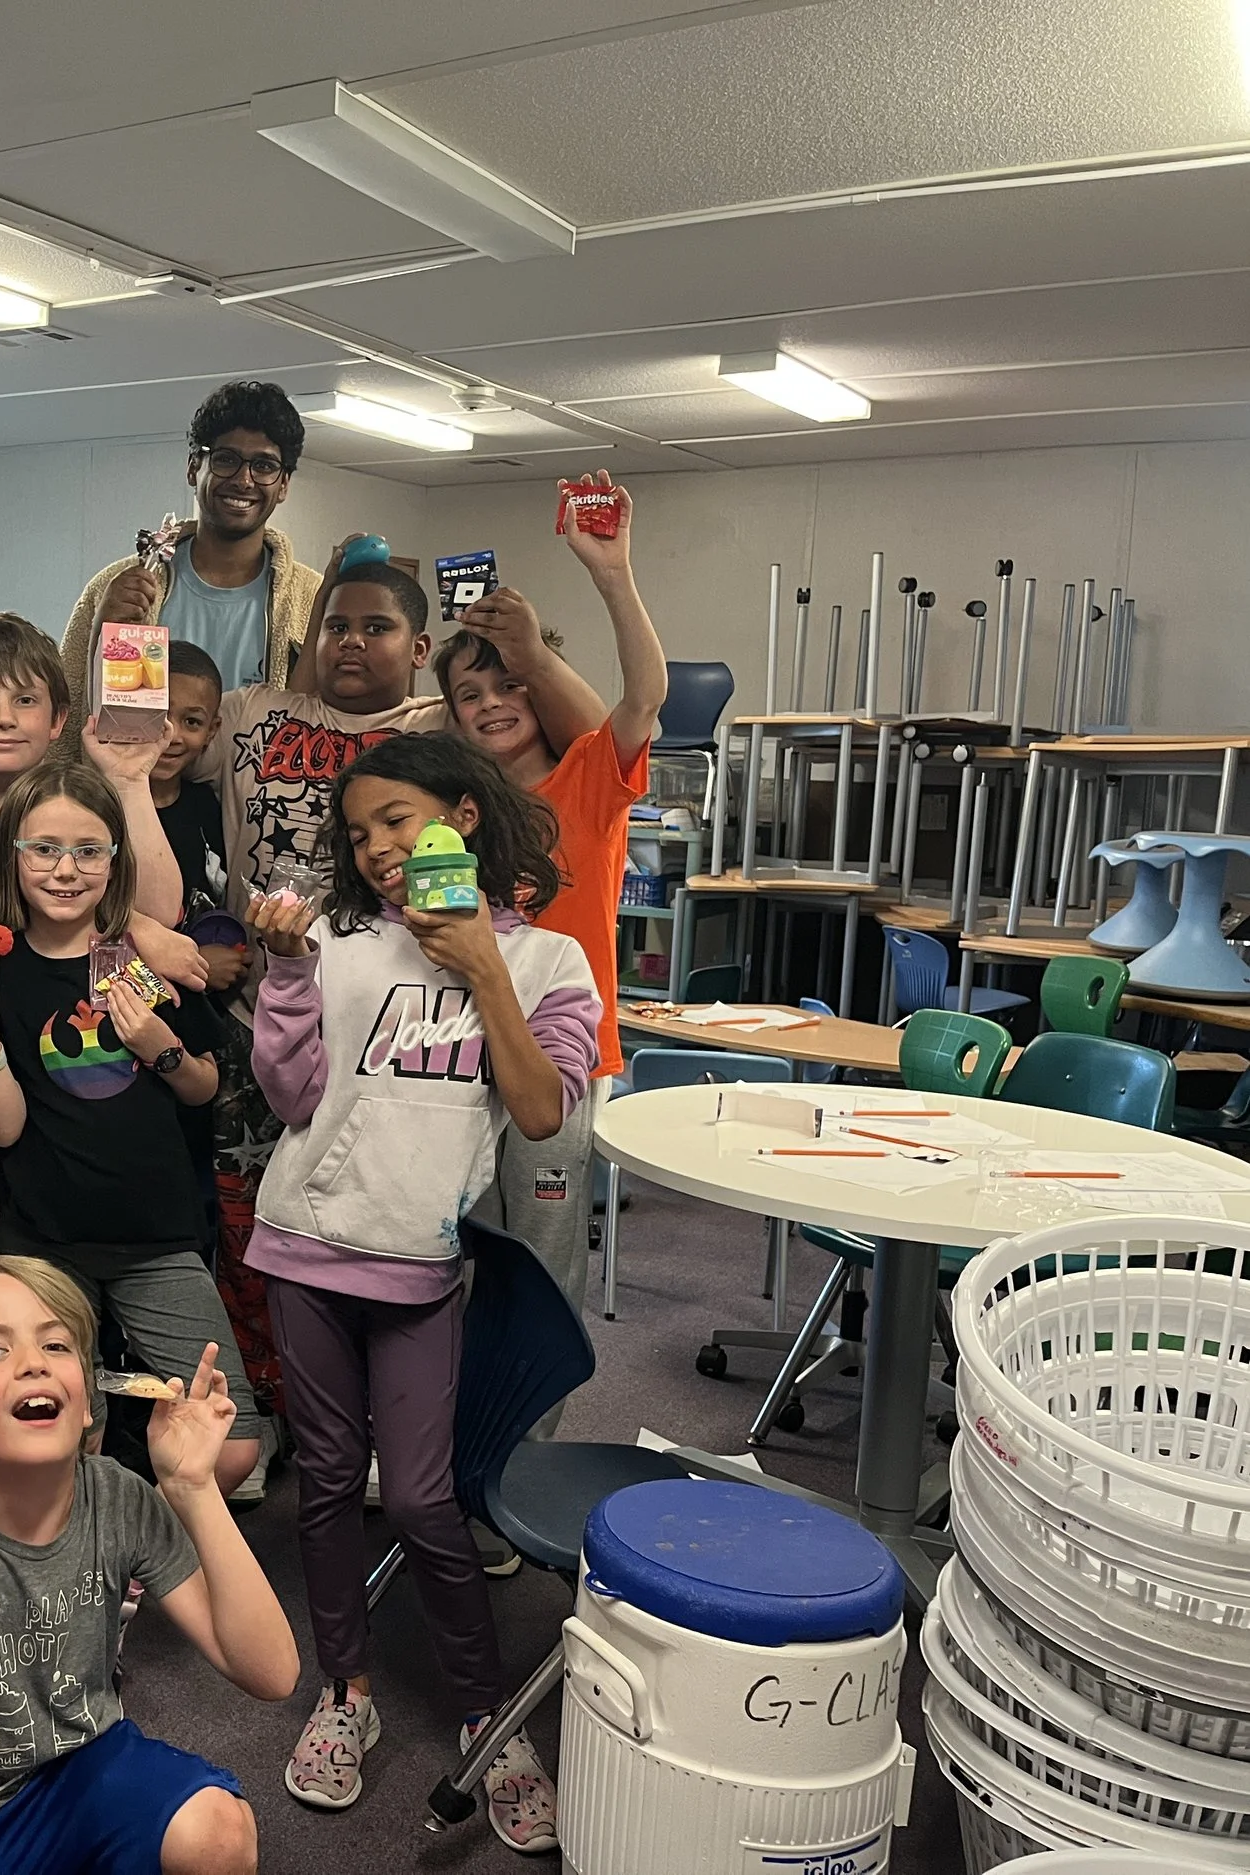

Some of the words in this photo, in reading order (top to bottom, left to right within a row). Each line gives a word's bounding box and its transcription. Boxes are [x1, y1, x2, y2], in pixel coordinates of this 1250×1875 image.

[568, 493, 615, 506] Skittles
[442, 563, 490, 578] ROBLOX
[139, 962, 166, 993] HARIBO
